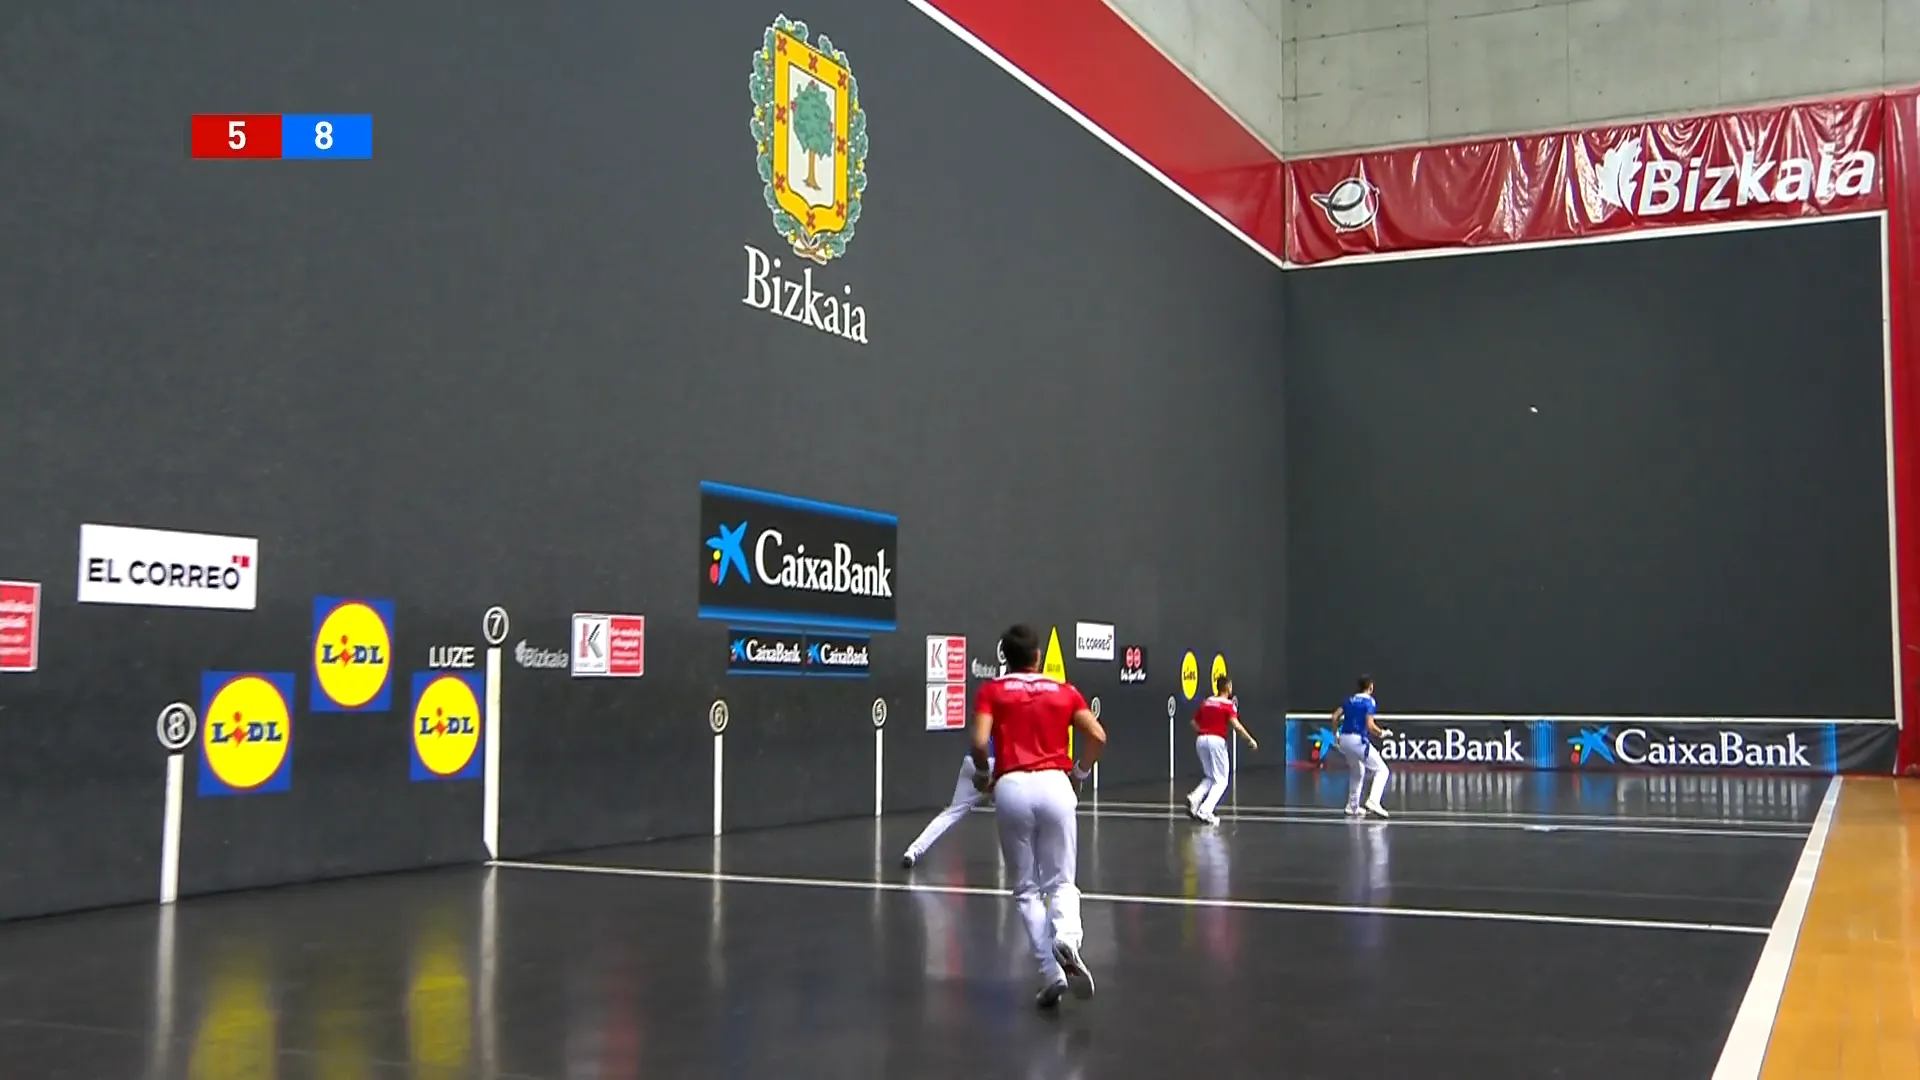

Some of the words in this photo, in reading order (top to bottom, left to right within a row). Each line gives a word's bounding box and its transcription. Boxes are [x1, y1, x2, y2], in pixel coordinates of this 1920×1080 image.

[1638, 143, 1876, 216] Bizkaia
[742, 245, 868, 344] Bizkaia
[88, 558, 122, 583] EL
[129, 560, 240, 590] CORREO
[755, 529, 892, 598] CaixaBank
[490, 613, 503, 637] 7
[430, 646, 475, 668] LUZE
[746, 639, 802, 663] CaixaBank
[820, 643, 869, 666] CaixaBank
[167, 711, 185, 740] 8
[1382, 728, 1524, 764] aixaBank
[1615, 728, 1811, 767] CaixaBank
